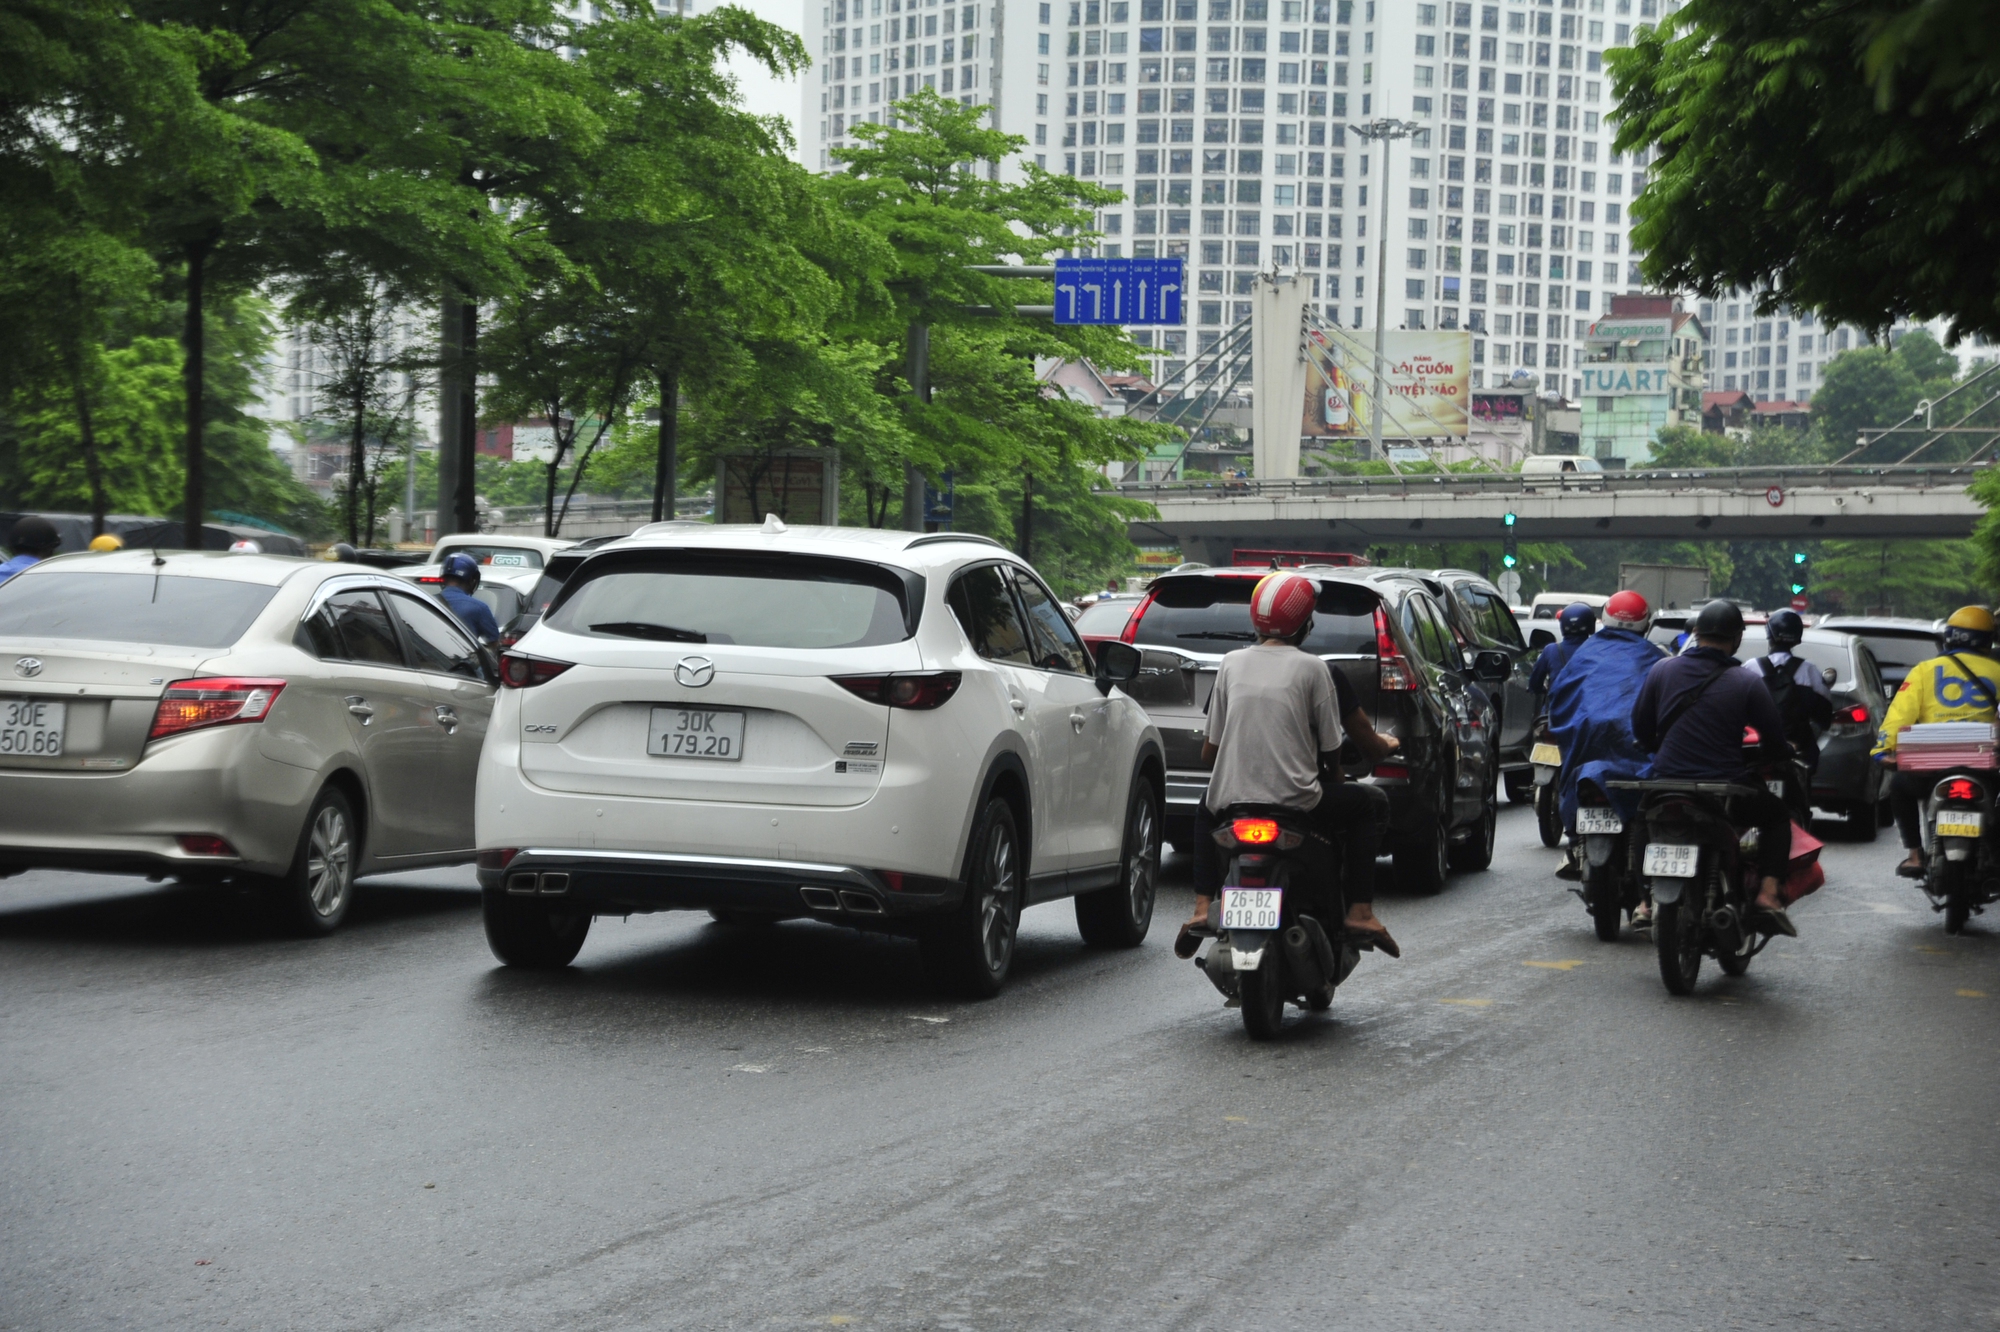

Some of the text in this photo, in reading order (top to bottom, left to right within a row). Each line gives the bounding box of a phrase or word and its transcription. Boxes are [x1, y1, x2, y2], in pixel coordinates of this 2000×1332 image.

[1581, 369, 1668, 391] TUART
[495, 556, 520, 565] Grab
[1934, 665, 1997, 709] be
[6, 703, 47, 728] 30E
[676, 711, 716, 733] 30K
[524, 723, 558, 734] CX-5
[661, 733, 731, 757] 179.20
[1651, 860, 1688, 875] 4293
[1230, 891, 1273, 908] 26-B2
[1225, 909, 1277, 927] 818.00
